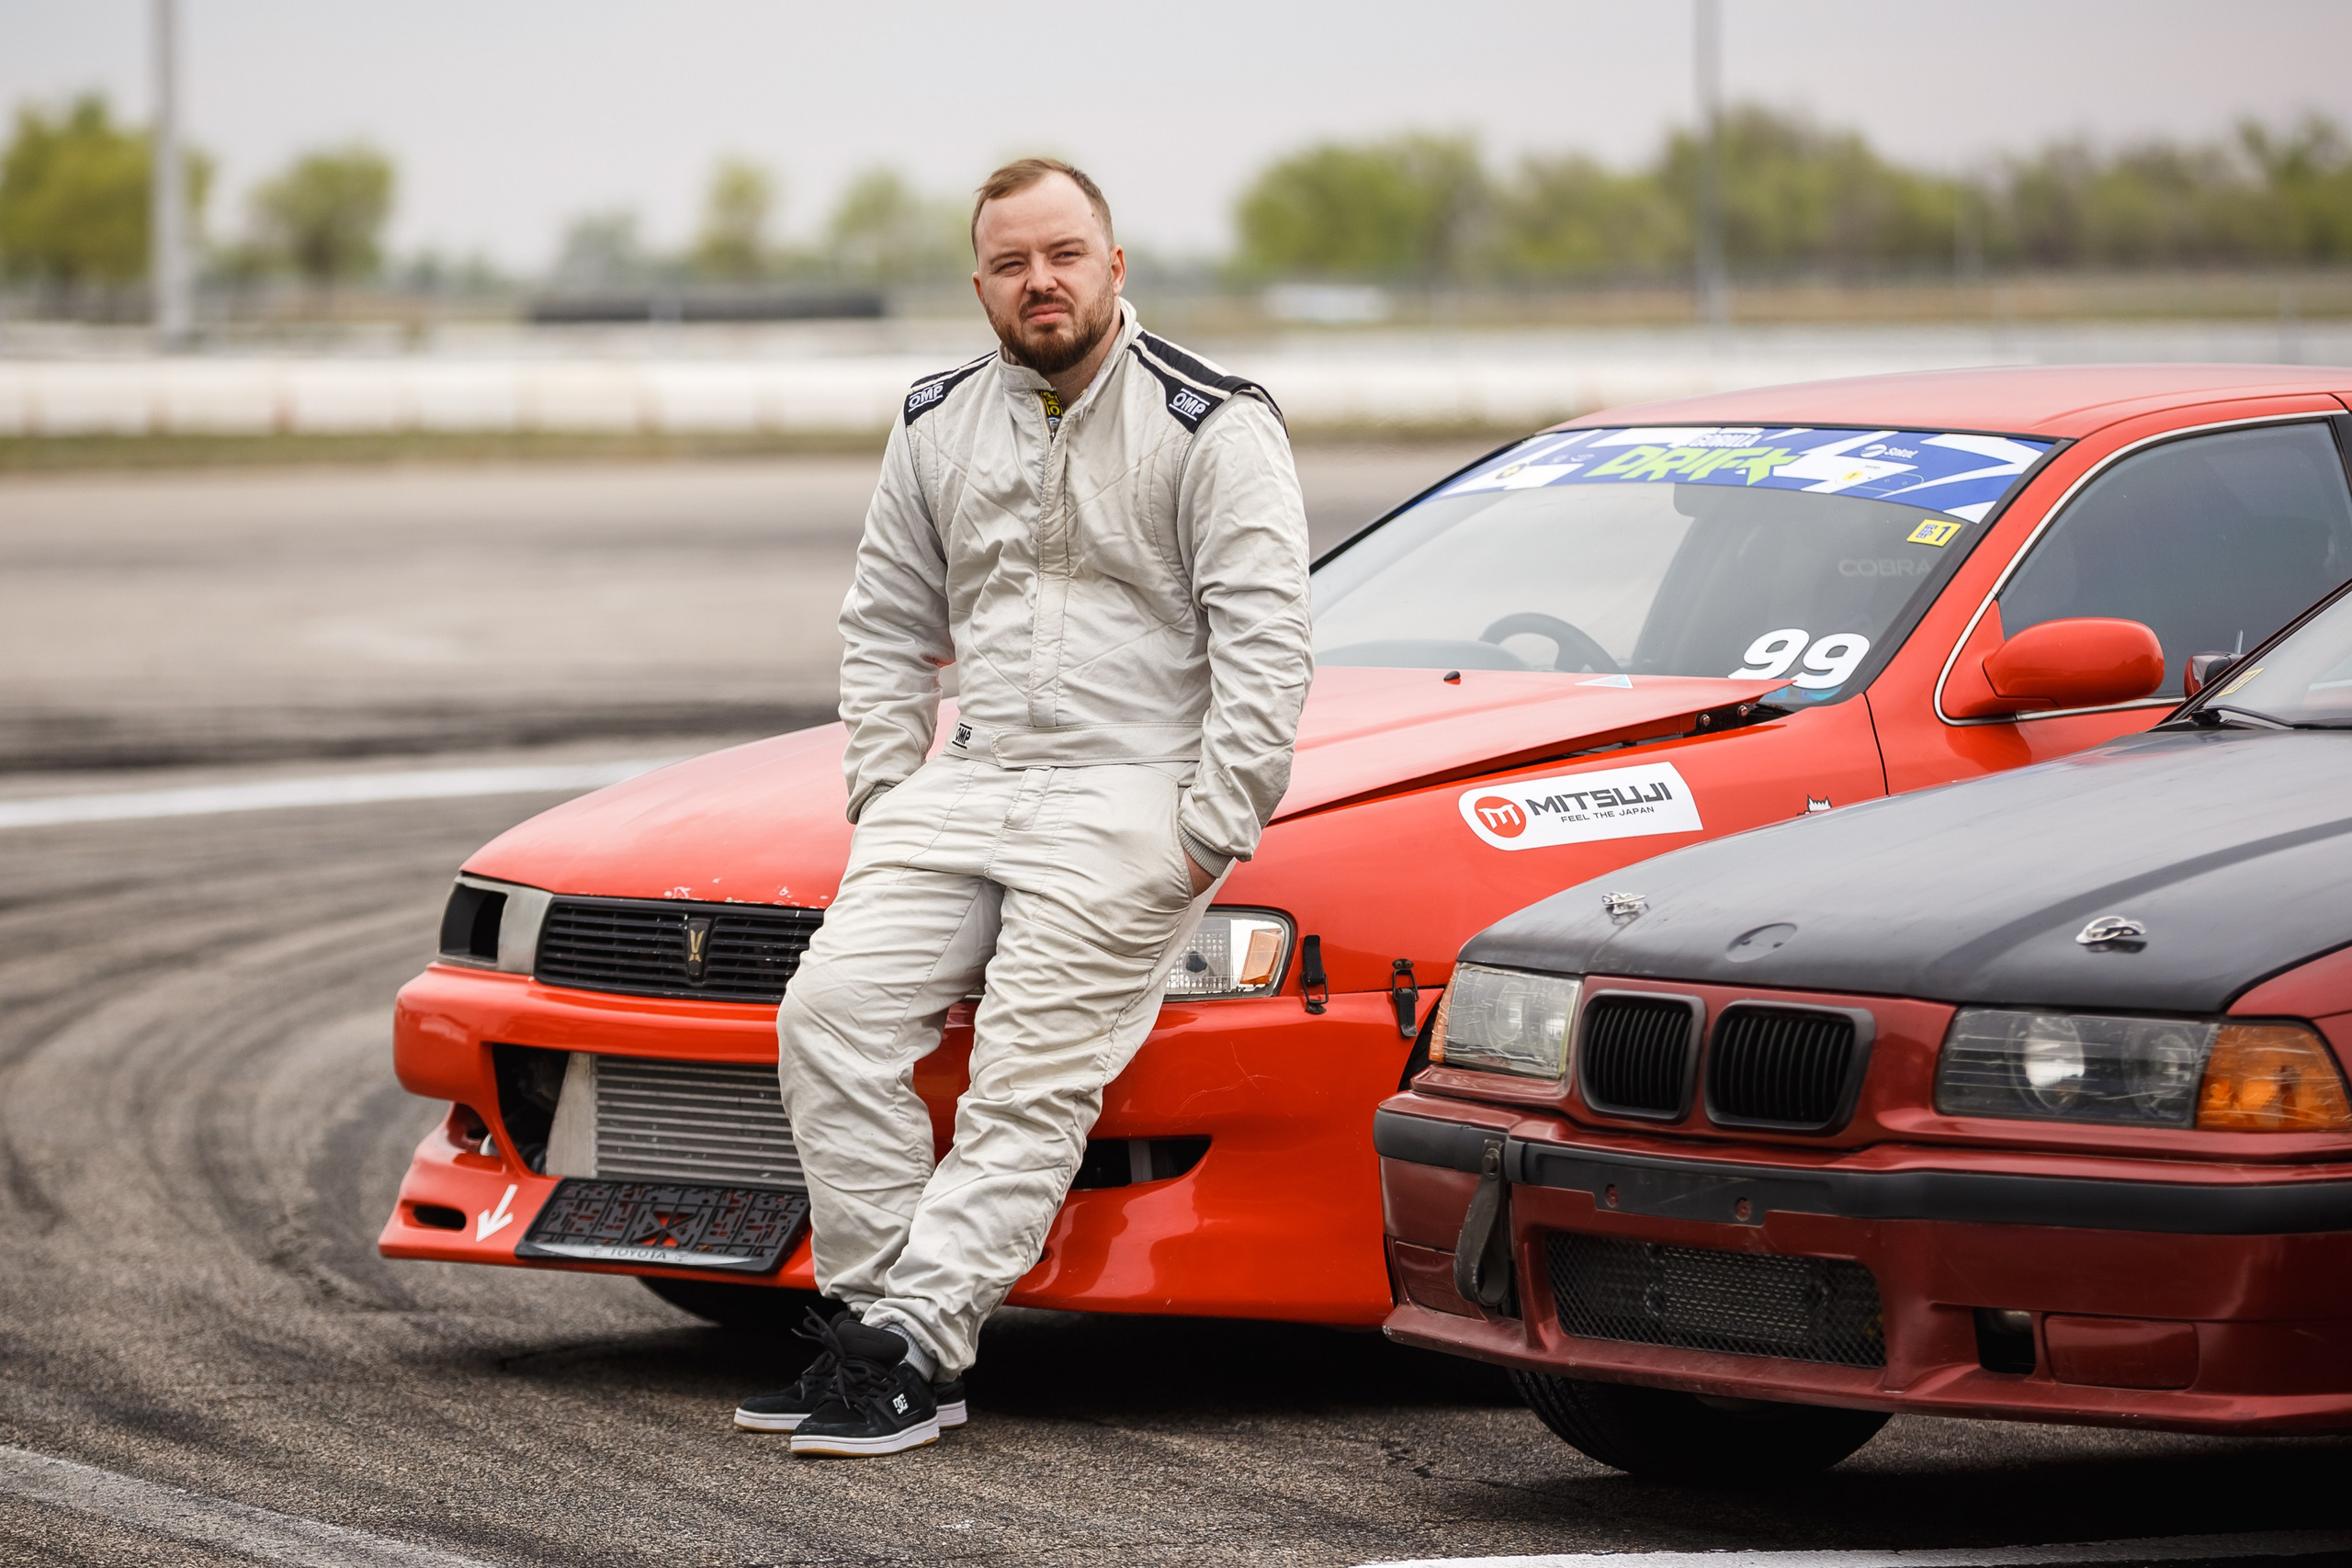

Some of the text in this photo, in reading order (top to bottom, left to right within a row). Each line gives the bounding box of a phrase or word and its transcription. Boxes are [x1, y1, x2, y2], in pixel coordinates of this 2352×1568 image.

[908, 383, 944, 410] OMP
[1172, 391, 1206, 417] OMP
[1582, 445, 1801, 487] DRIFT
[1934, 525, 1952, 542] 1
[1838, 558, 1932, 578] COBRA
[1728, 628, 1871, 690] 99
[956, 727, 971, 745] OMP
[1525, 782, 1673, 817] MITSUJI
[1560, 806, 1656, 824] FEEL THE JAPAN
[611, 1247, 666, 1259] TOYOTA
